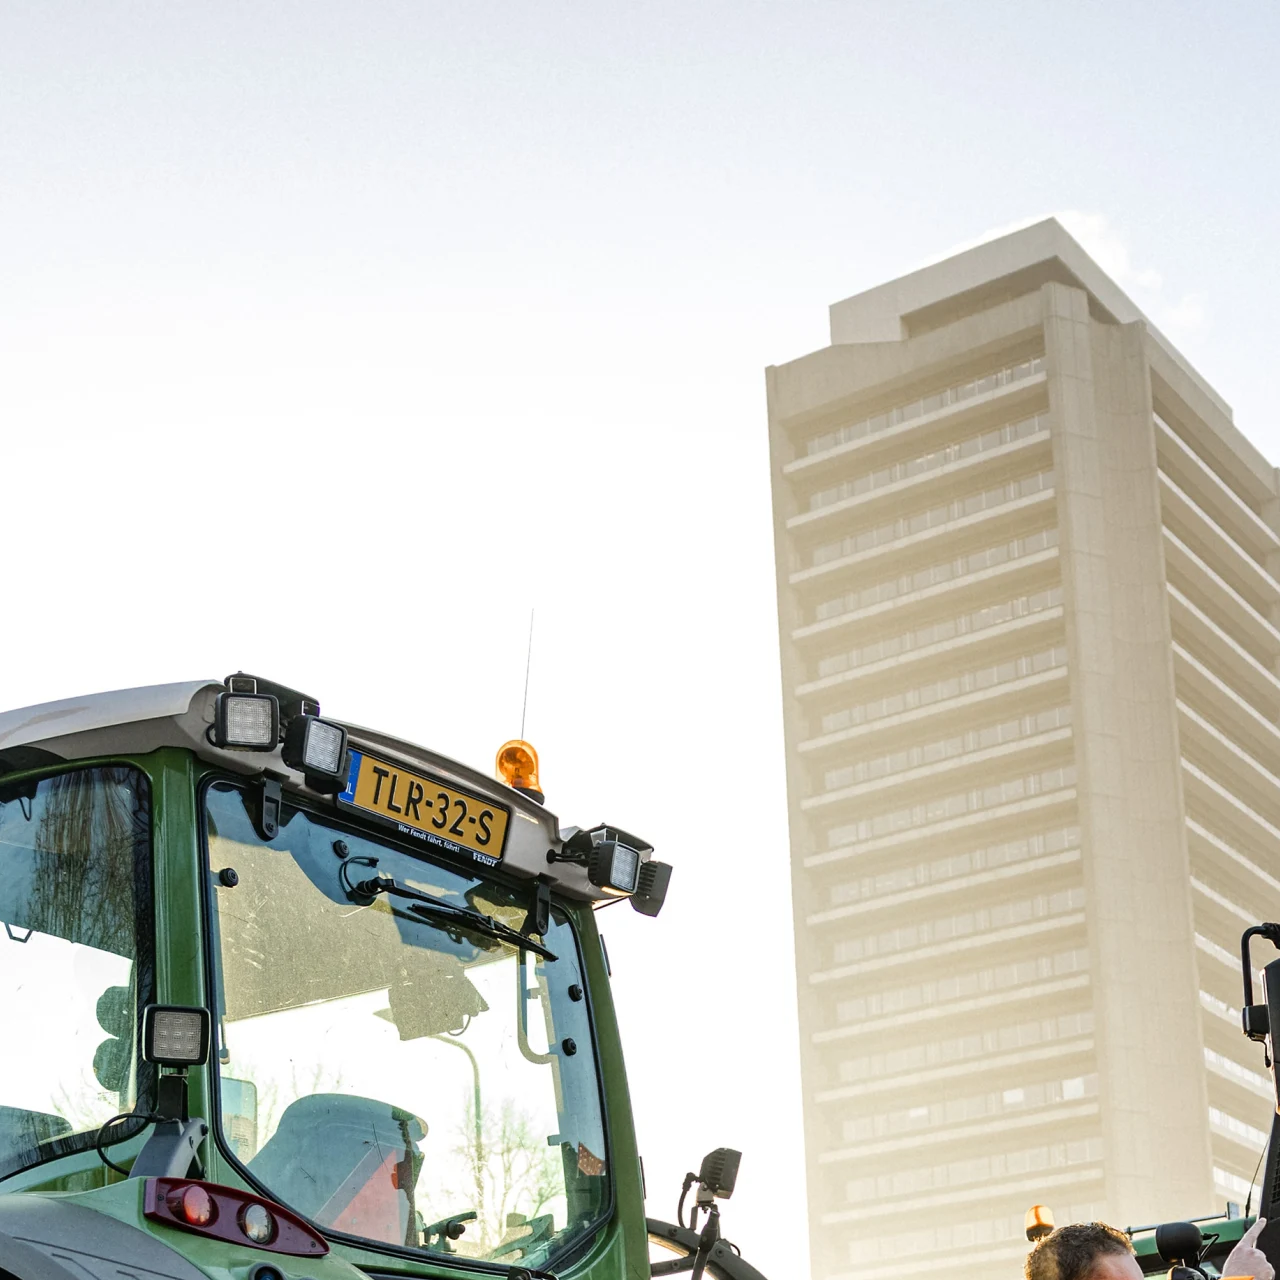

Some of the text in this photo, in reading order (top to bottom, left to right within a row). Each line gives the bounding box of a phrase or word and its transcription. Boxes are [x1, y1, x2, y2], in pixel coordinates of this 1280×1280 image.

[372, 766, 494, 846] TLR-32-S
[398, 823, 410, 834] Wer
[410, 828, 427, 841] Fendt
[473, 852, 497, 867] FENDT
